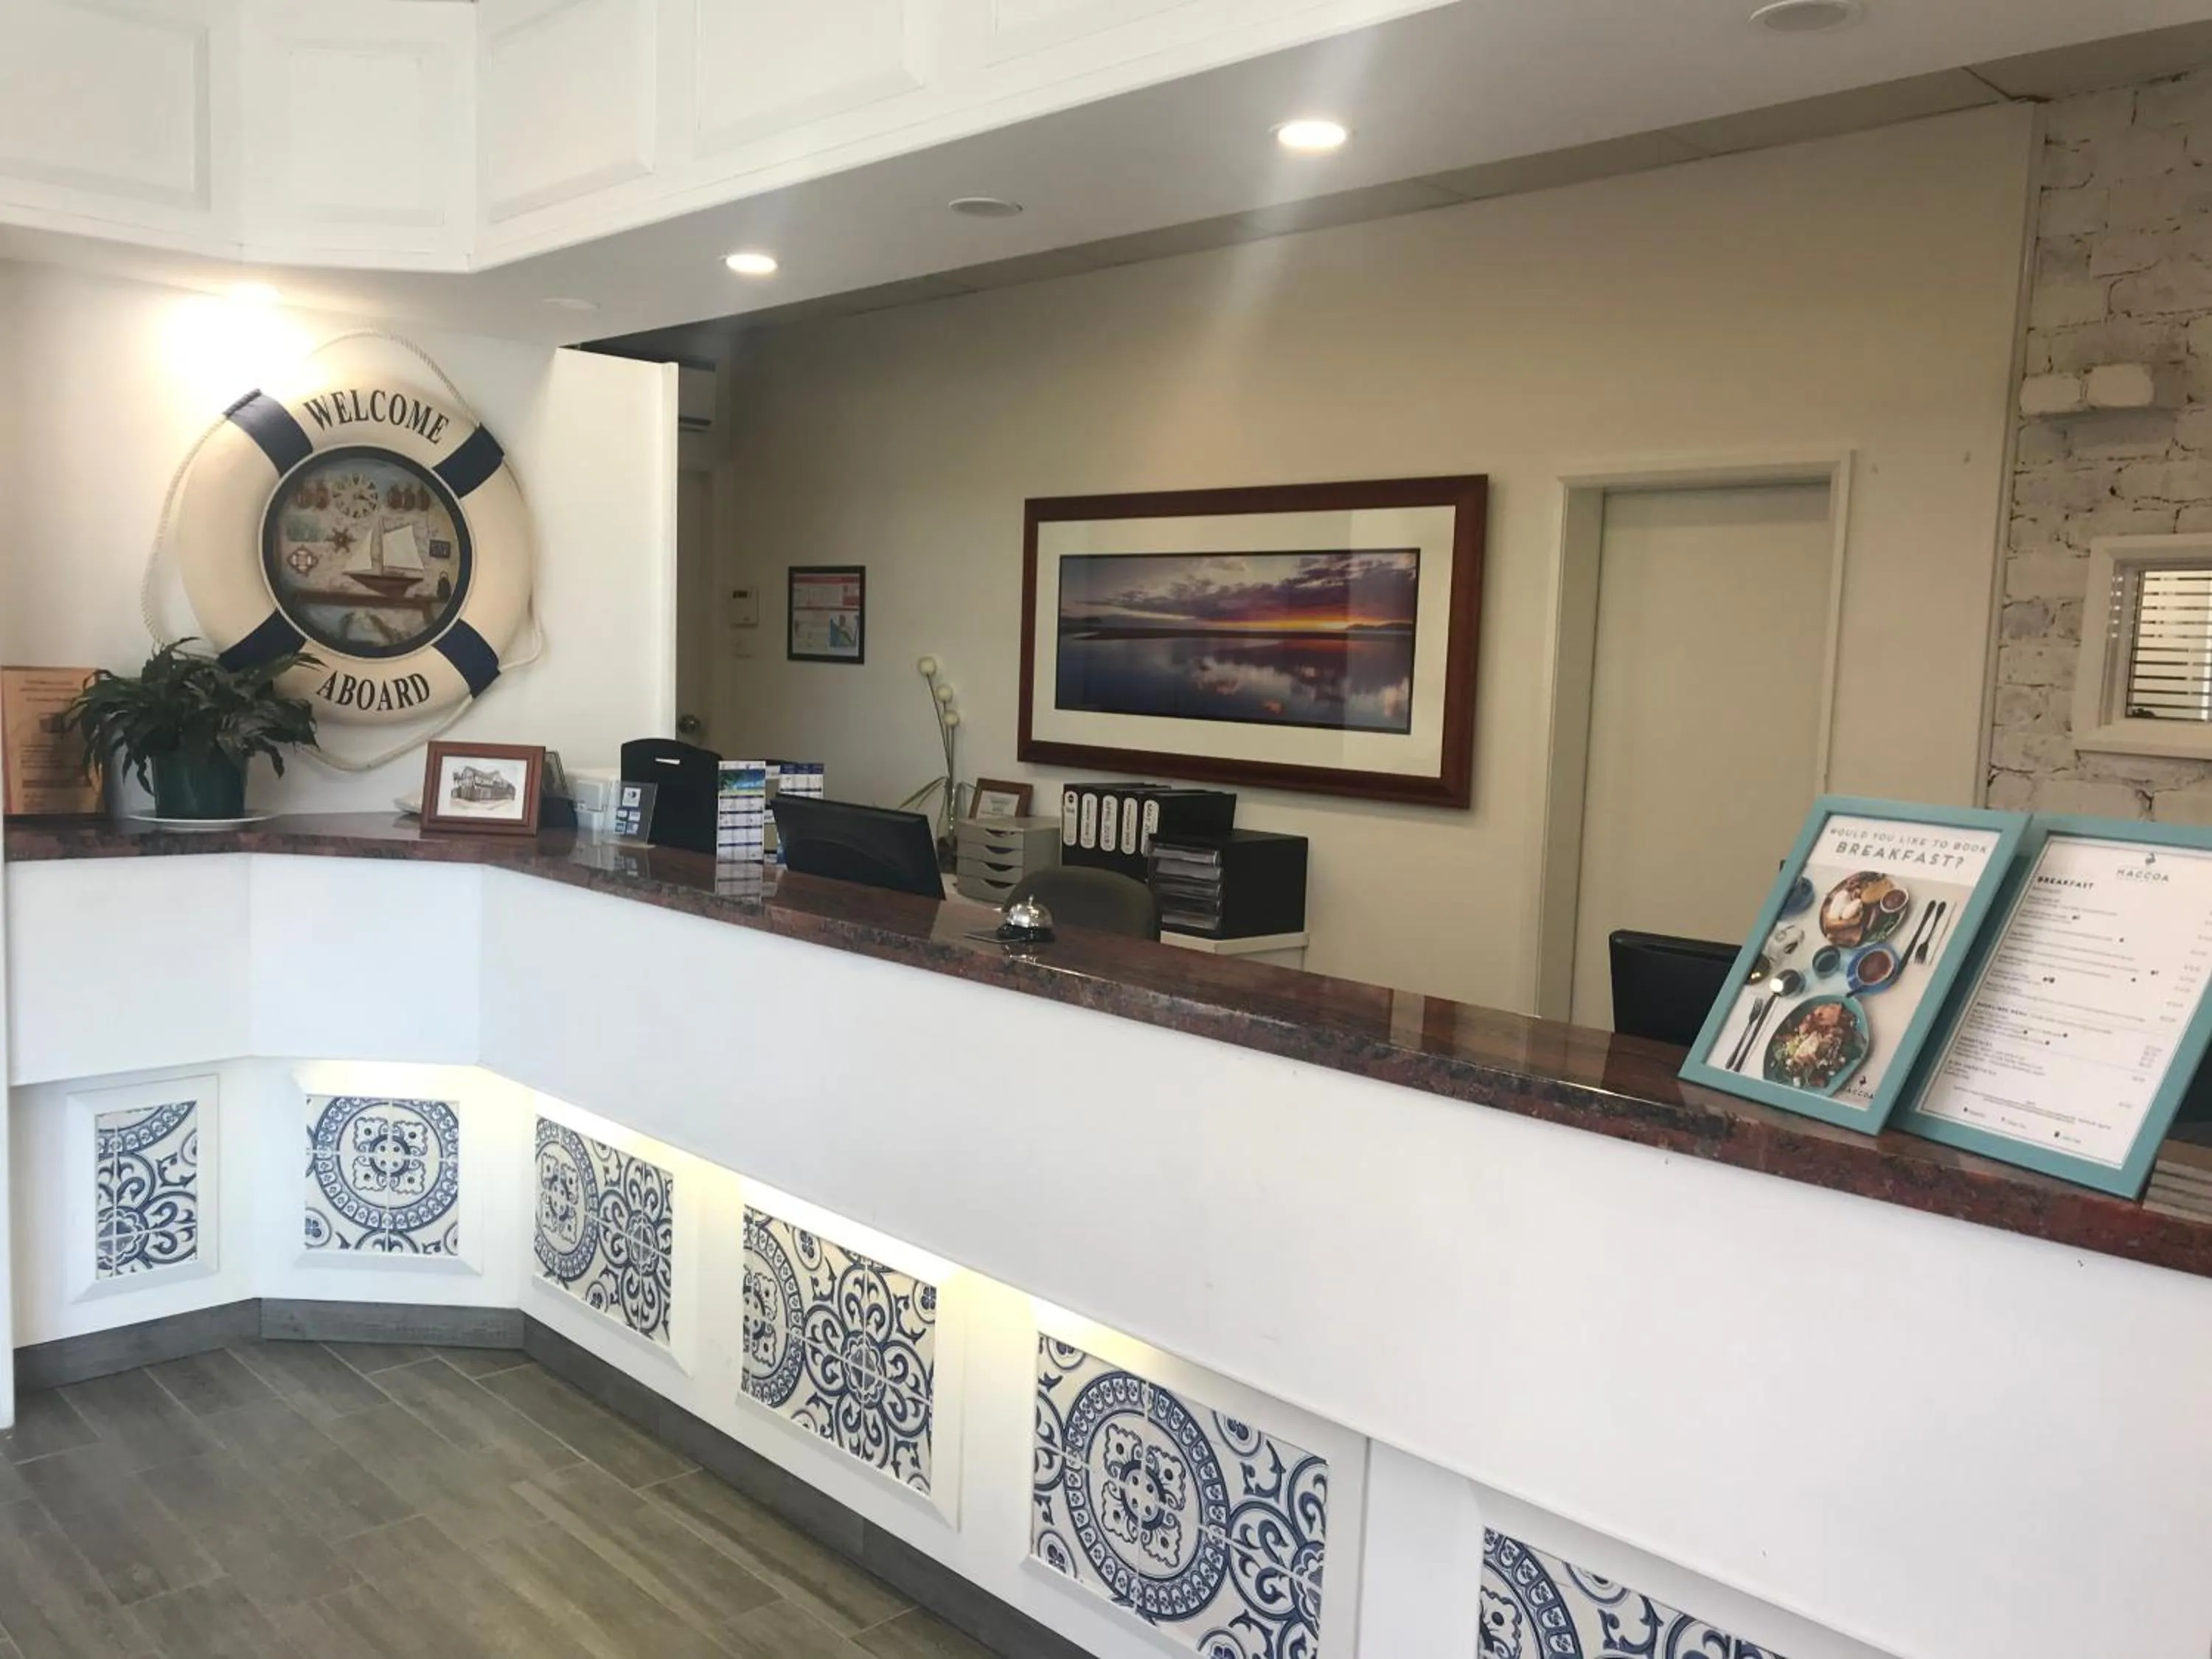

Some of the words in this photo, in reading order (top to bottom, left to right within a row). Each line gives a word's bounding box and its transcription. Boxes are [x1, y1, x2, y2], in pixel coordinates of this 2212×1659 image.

[302, 389, 449, 445] WELCOME
[316, 669, 430, 712] ABOARD
[1829, 827, 1868, 839] WOULD
[1873, 832, 1896, 842] YOU
[1899, 835, 1927, 847] LIKE
[1931, 838, 1949, 849] TO
[1952, 842, 1989, 855] BOOK
[1834, 840, 1965, 869] BREAKFAST?
[2037, 874, 2095, 891] BREAKFAST
